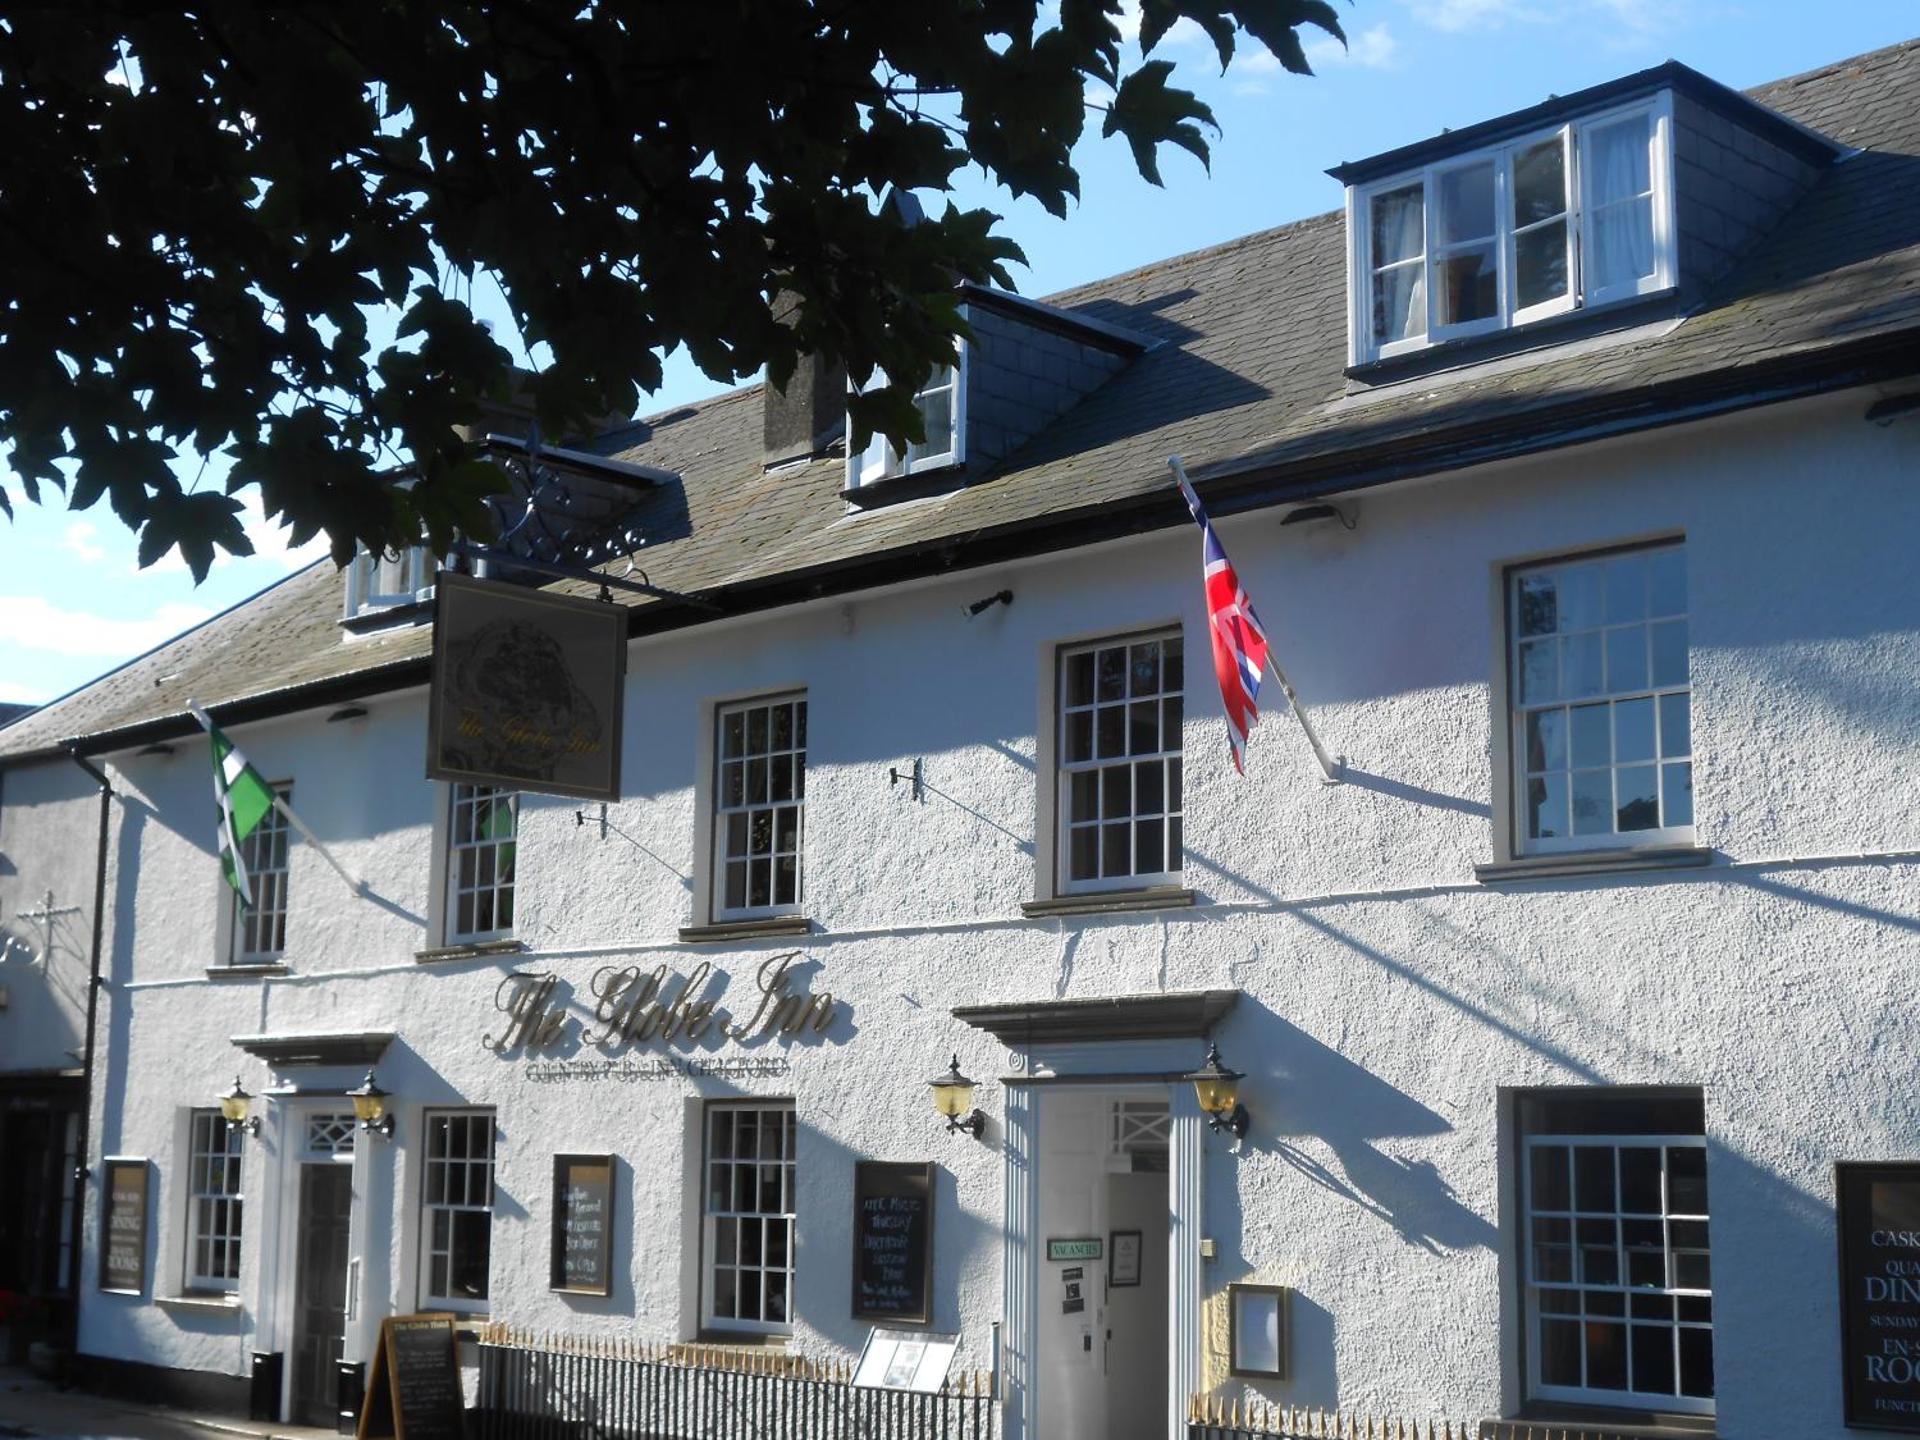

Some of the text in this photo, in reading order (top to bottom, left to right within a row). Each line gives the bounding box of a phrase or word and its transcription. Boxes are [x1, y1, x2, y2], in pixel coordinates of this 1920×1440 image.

[482, 950, 837, 1051] The Globe Inn
[1871, 1230, 1920, 1247] CASK
[1864, 1277, 1920, 1303] DIN
[1865, 1354, 1920, 1384] RO
